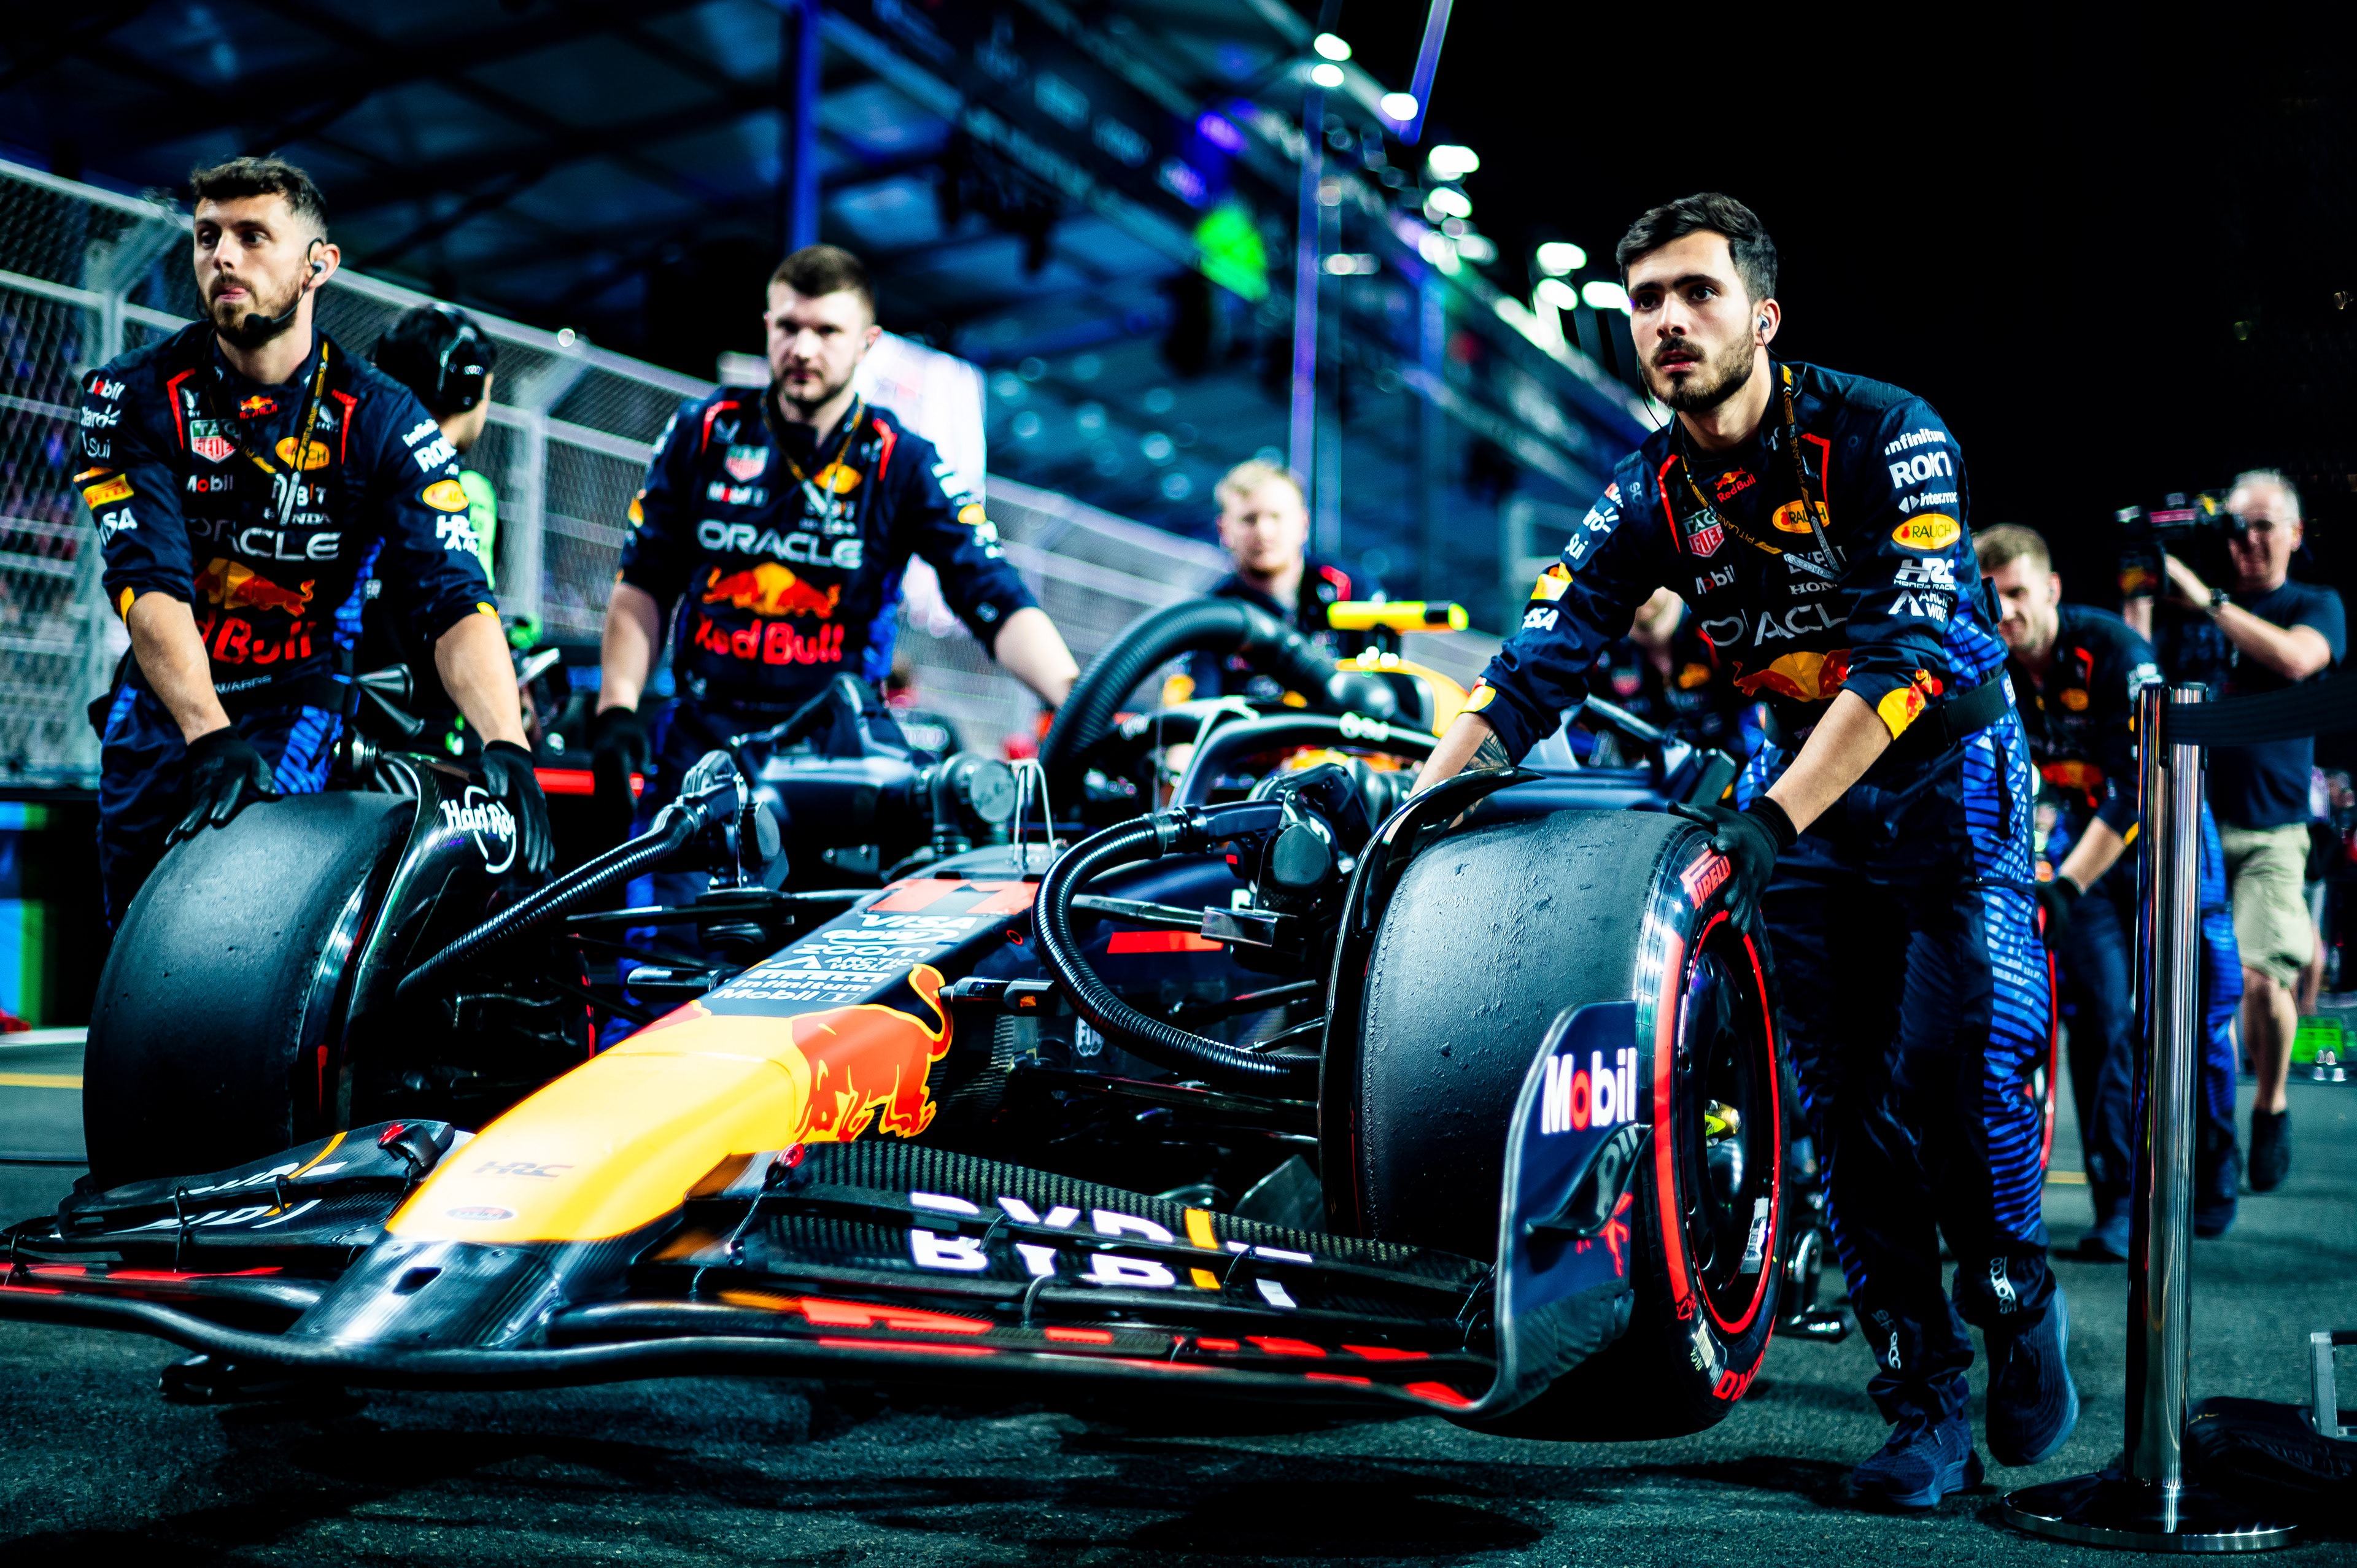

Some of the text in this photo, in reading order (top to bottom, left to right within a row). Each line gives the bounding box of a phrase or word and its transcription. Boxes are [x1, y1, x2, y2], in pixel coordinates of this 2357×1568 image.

[1790, 437, 1802, 467] LANE
[1717, 474, 1756, 502] Red Bull
[1797, 468, 1806, 484] PIT
[1683, 511, 1718, 535] TAG
[1788, 507, 1827, 524] RAUH
[1717, 513, 1755, 544] PIT LANE
[1913, 523, 1951, 538] RAUCH
[698, 520, 863, 570] ORACLE
[1565, 533, 1589, 560] Sui
[1895, 557, 1955, 584] HRC
[212, 615, 317, 665] Bull
[762, 622, 845, 665] Bull
[867, 878, 1039, 915] 11
[858, 913, 977, 929] VISA
[824, 956, 915, 967] ARCTIC
[829, 962, 898, 971] WOLF
[731, 979, 872, 992] infinitum
[746, 969, 891, 983] PIRELLI
[712, 988, 821, 1001] Mobil
[1541, 1047, 1638, 1135] Mobil
[470, 1161, 576, 1178] HRC
